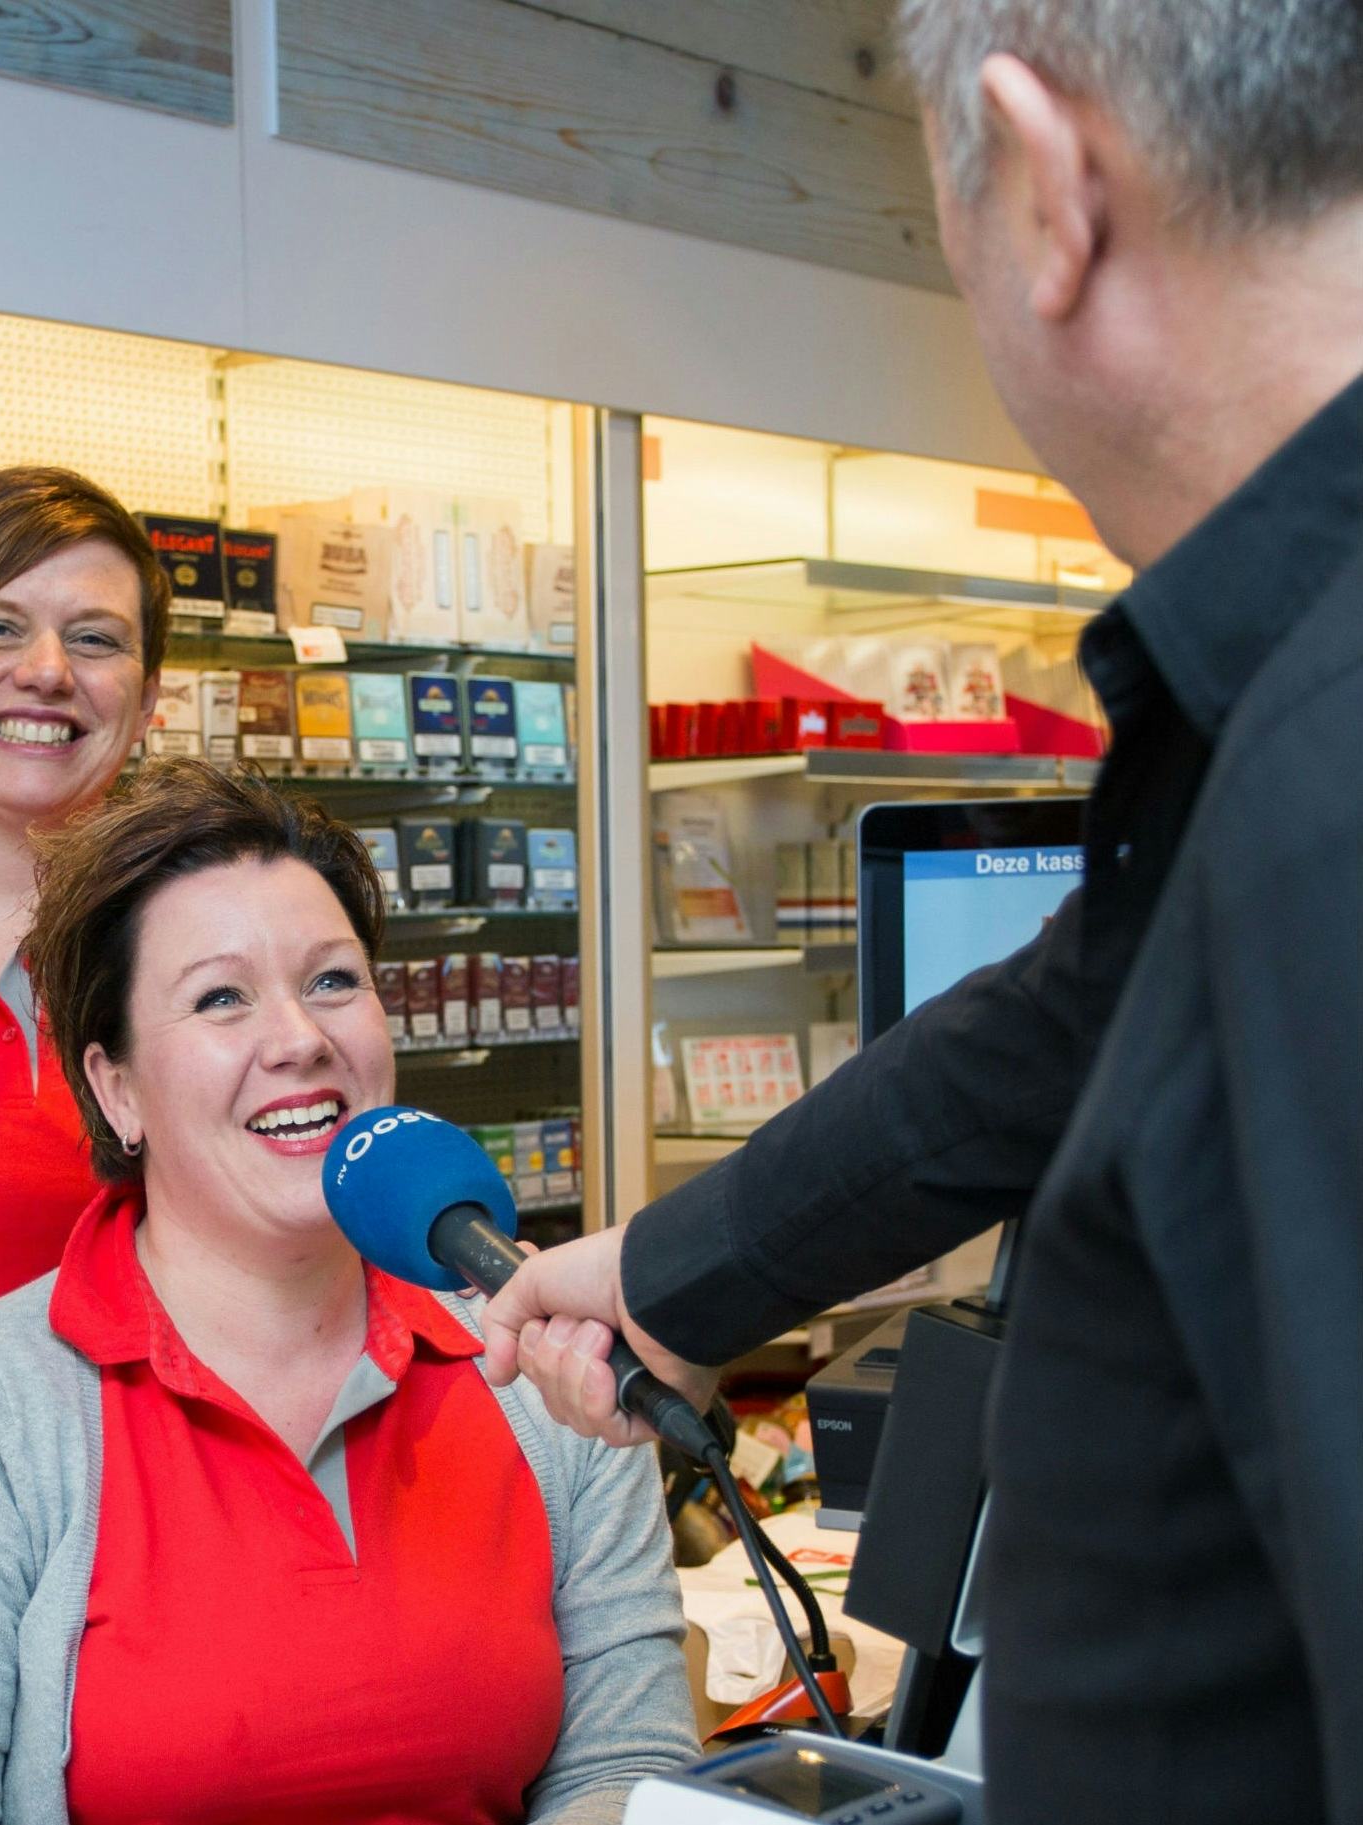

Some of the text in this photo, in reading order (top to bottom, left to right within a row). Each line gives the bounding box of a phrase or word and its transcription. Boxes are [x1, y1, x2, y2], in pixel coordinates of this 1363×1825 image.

[150, 529, 215, 554] ELEGANT
[976, 851, 1085, 875] Deze kass
[817, 1419, 853, 1431] EPSON
